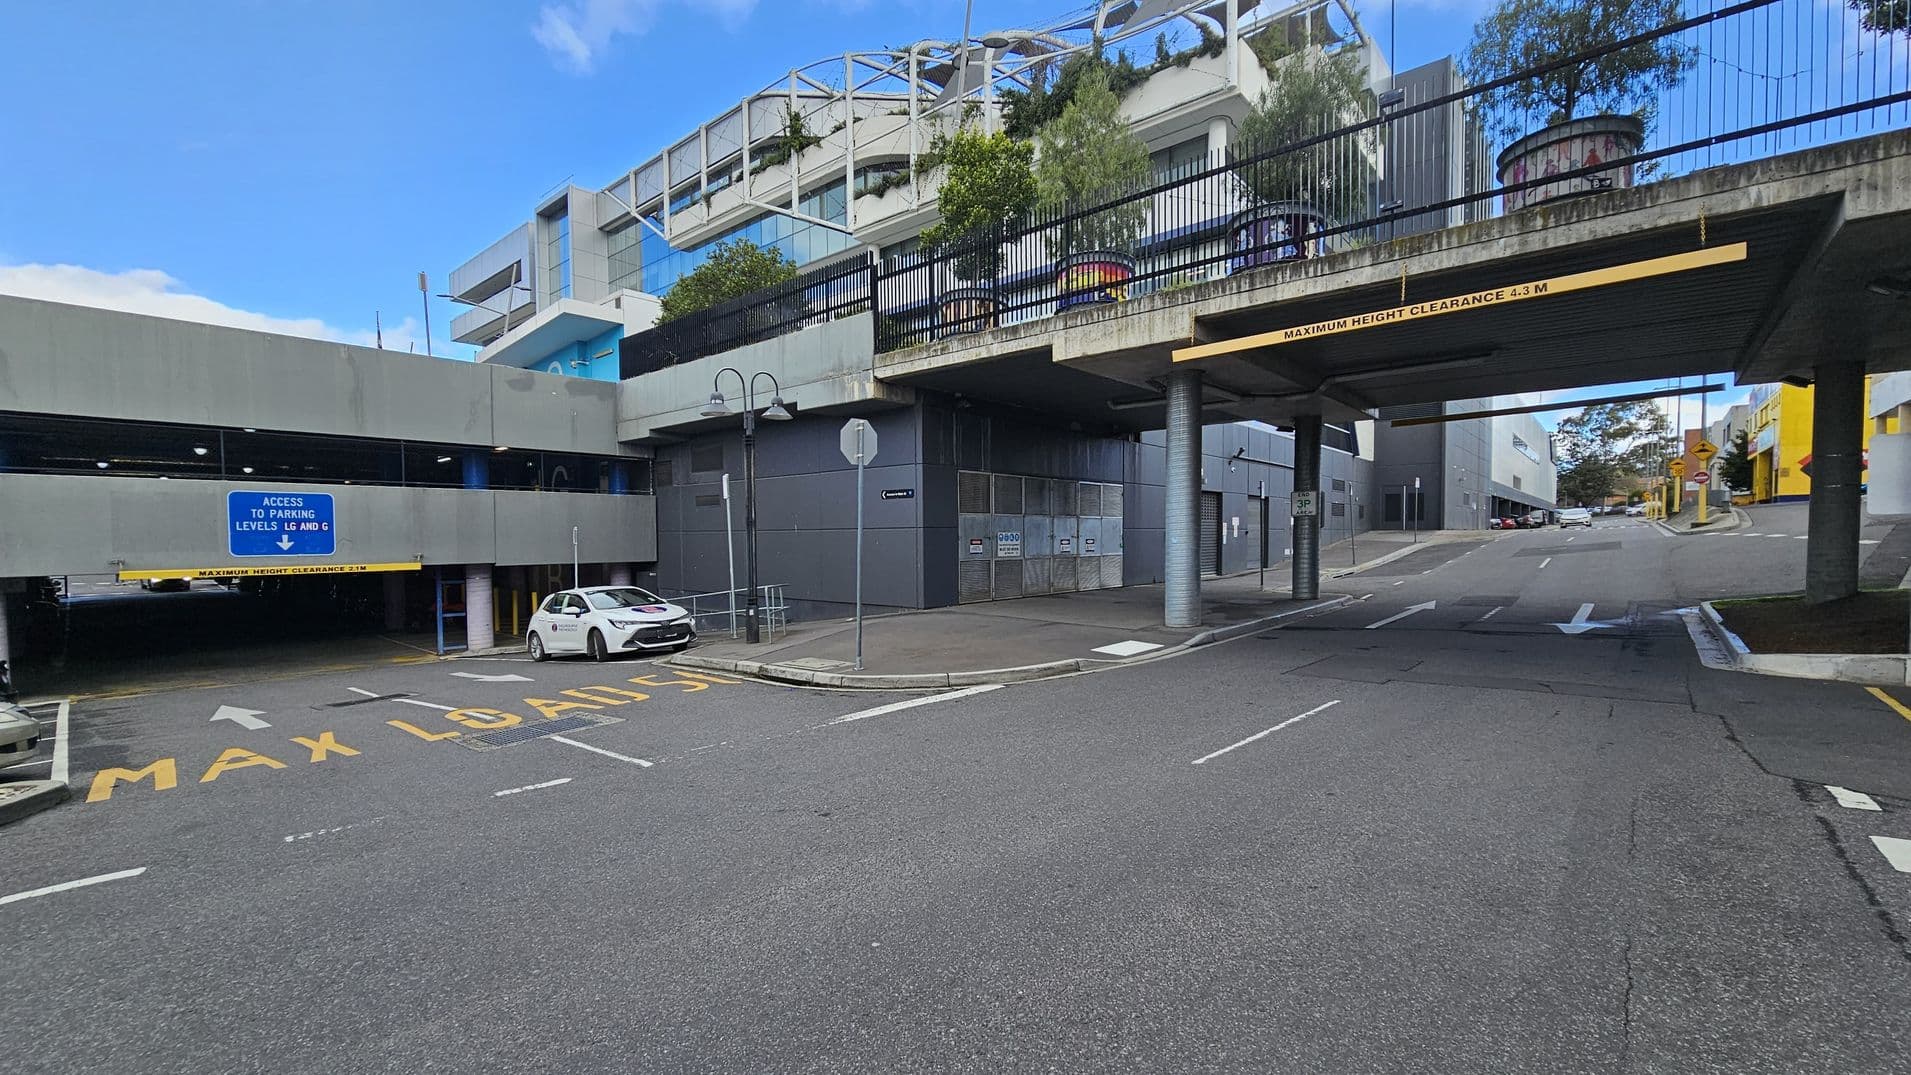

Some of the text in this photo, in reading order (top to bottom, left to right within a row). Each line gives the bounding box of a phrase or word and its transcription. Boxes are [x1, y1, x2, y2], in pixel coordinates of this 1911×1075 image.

[1284, 282, 1549, 340] MAXIMUM HEIGHT CLEARANCE 4.3 M
[263, 497, 303, 507] ACCESS
[1297, 499, 1311, 508] 3P
[251, 509, 316, 519] TO PARKING
[236, 521, 329, 531] LEVELS LG AND G
[199, 569, 249, 577] MAXIMUM
[292, 566, 345, 574] CLEARANCE
[84, 731, 362, 803] MAX
[385, 685, 650, 742] LOAD
